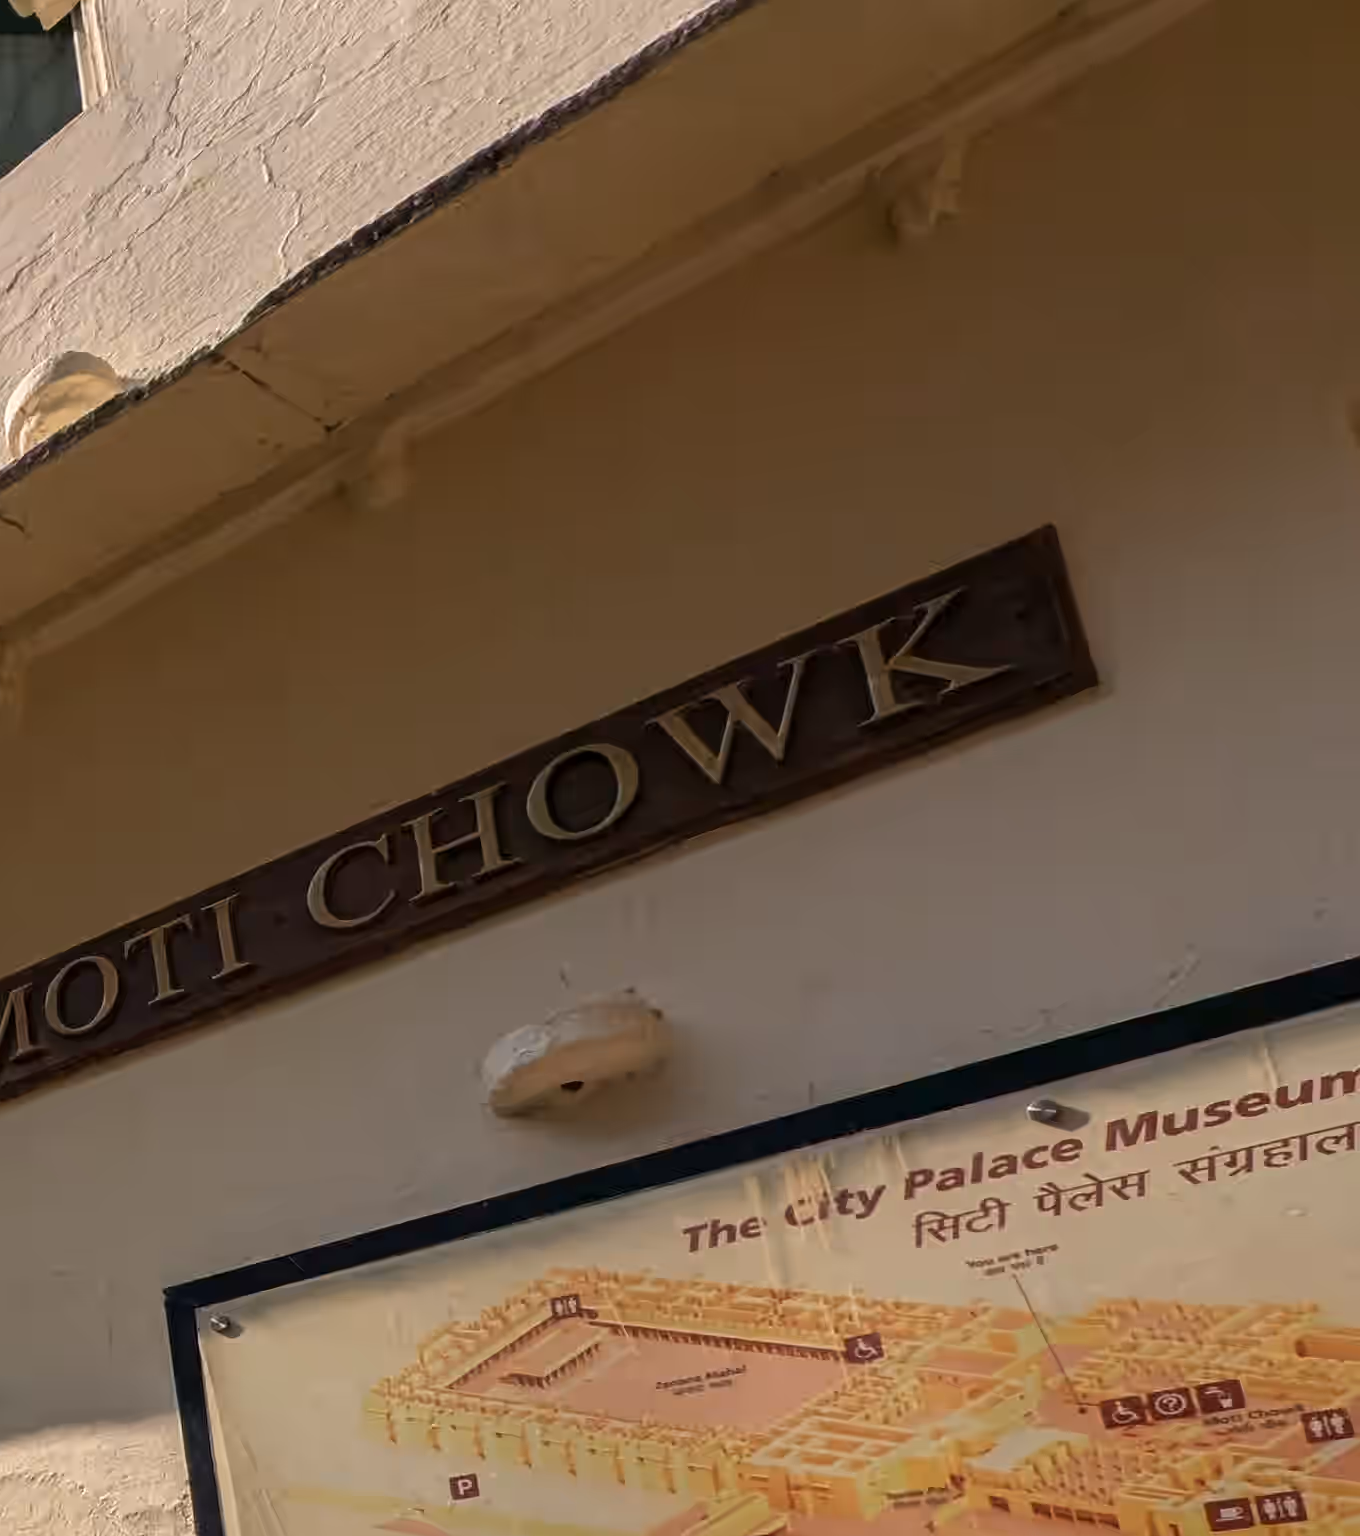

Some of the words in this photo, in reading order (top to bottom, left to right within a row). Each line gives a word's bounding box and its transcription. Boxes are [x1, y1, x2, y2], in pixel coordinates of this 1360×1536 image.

[305, 586, 1020, 931] CHOWK
[682, 1217, 767, 1252] The
[785, 1184, 886, 1226] City
[904, 1138, 1083, 1200] Palace
[1104, 1066, 1360, 1151] Museum
[912, 1197, 1011, 1248] सिटी
[1033, 1169, 1150, 1216] पैलेस
[1173, 1121, 1360, 1184] संग्रहाल
